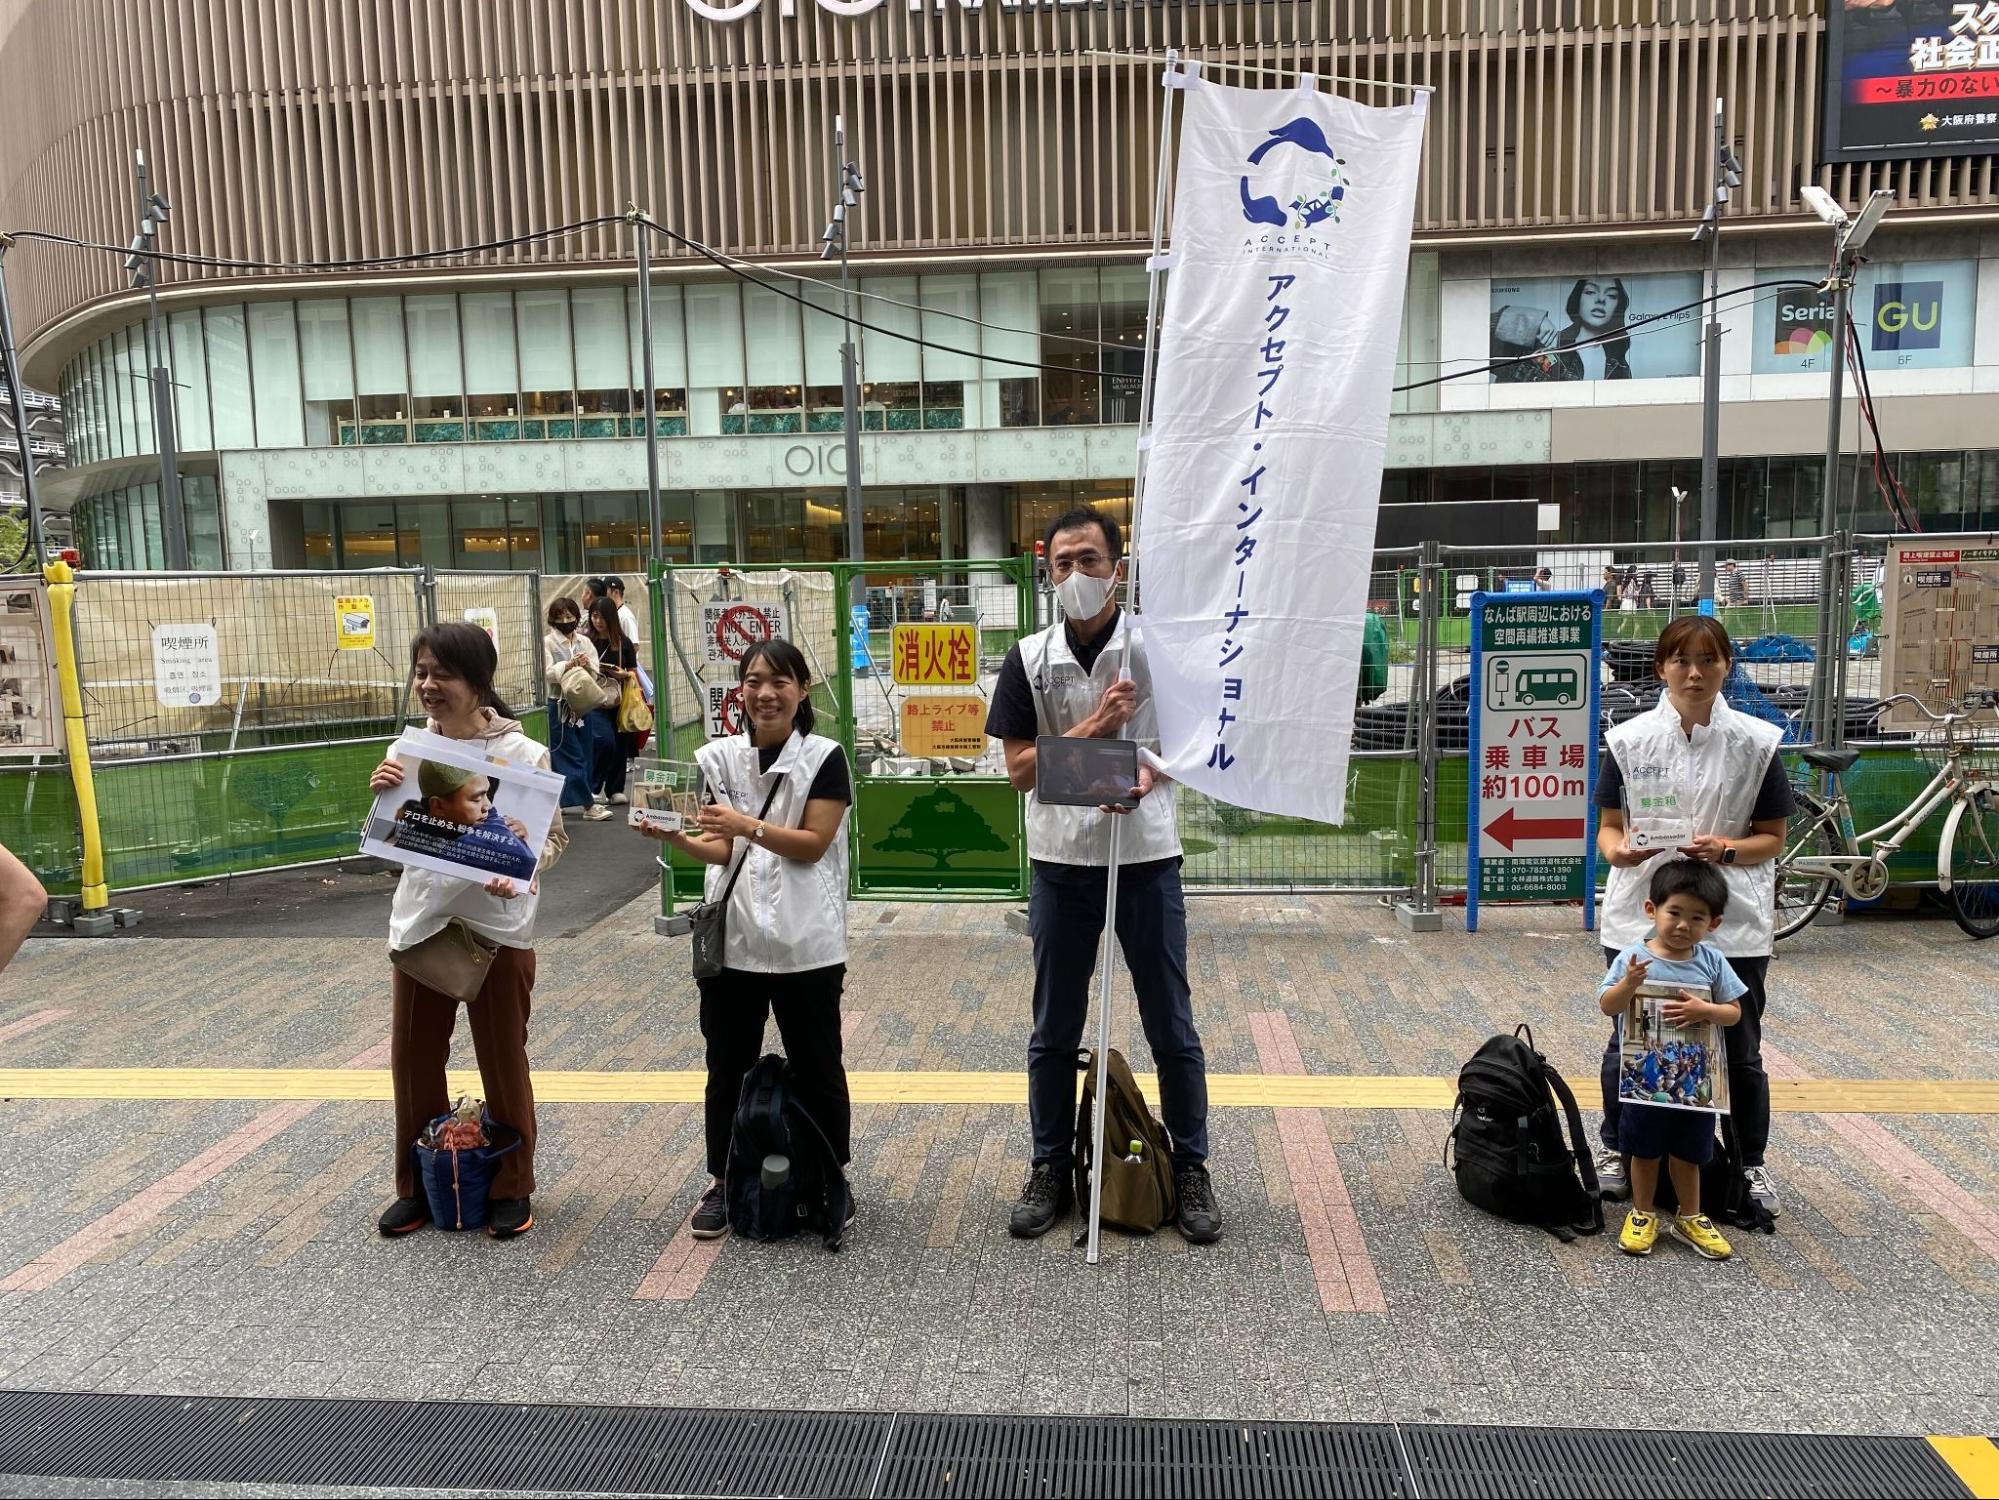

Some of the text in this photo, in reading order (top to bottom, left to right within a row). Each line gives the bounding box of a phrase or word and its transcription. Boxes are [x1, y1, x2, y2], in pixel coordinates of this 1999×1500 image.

[1941, 113, 1998, 127] 大阪府警察
[1245, 235, 1331, 250] ACCEPT
[1243, 246, 1329, 259] INTERNATIONAL
[1781, 302, 1836, 322] Seria
[1877, 301, 1938, 332] GU
[1801, 358, 1815, 368] 4F
[1207, 274, 1295, 770] アクセプト・インターナショナル
[704, 607, 780, 620] 関係者以外立禁止
[1484, 605, 1592, 624] なんば駅周辺における
[750, 620, 781, 633] ENER
[161, 636, 208, 650] 喫煙所
[1494, 626, 1580, 645] 空間再編推進事業
[898, 628, 971, 681] 消火栓
[907, 703, 979, 716] 路上ライブ等
[931, 720, 955, 732] 禁止
[1507, 716, 1562, 739] バス
[1485, 744, 1585, 770] 乗車場
[1633, 766, 1670, 775] ACCEPT
[1482, 775, 1585, 799] 約100m
